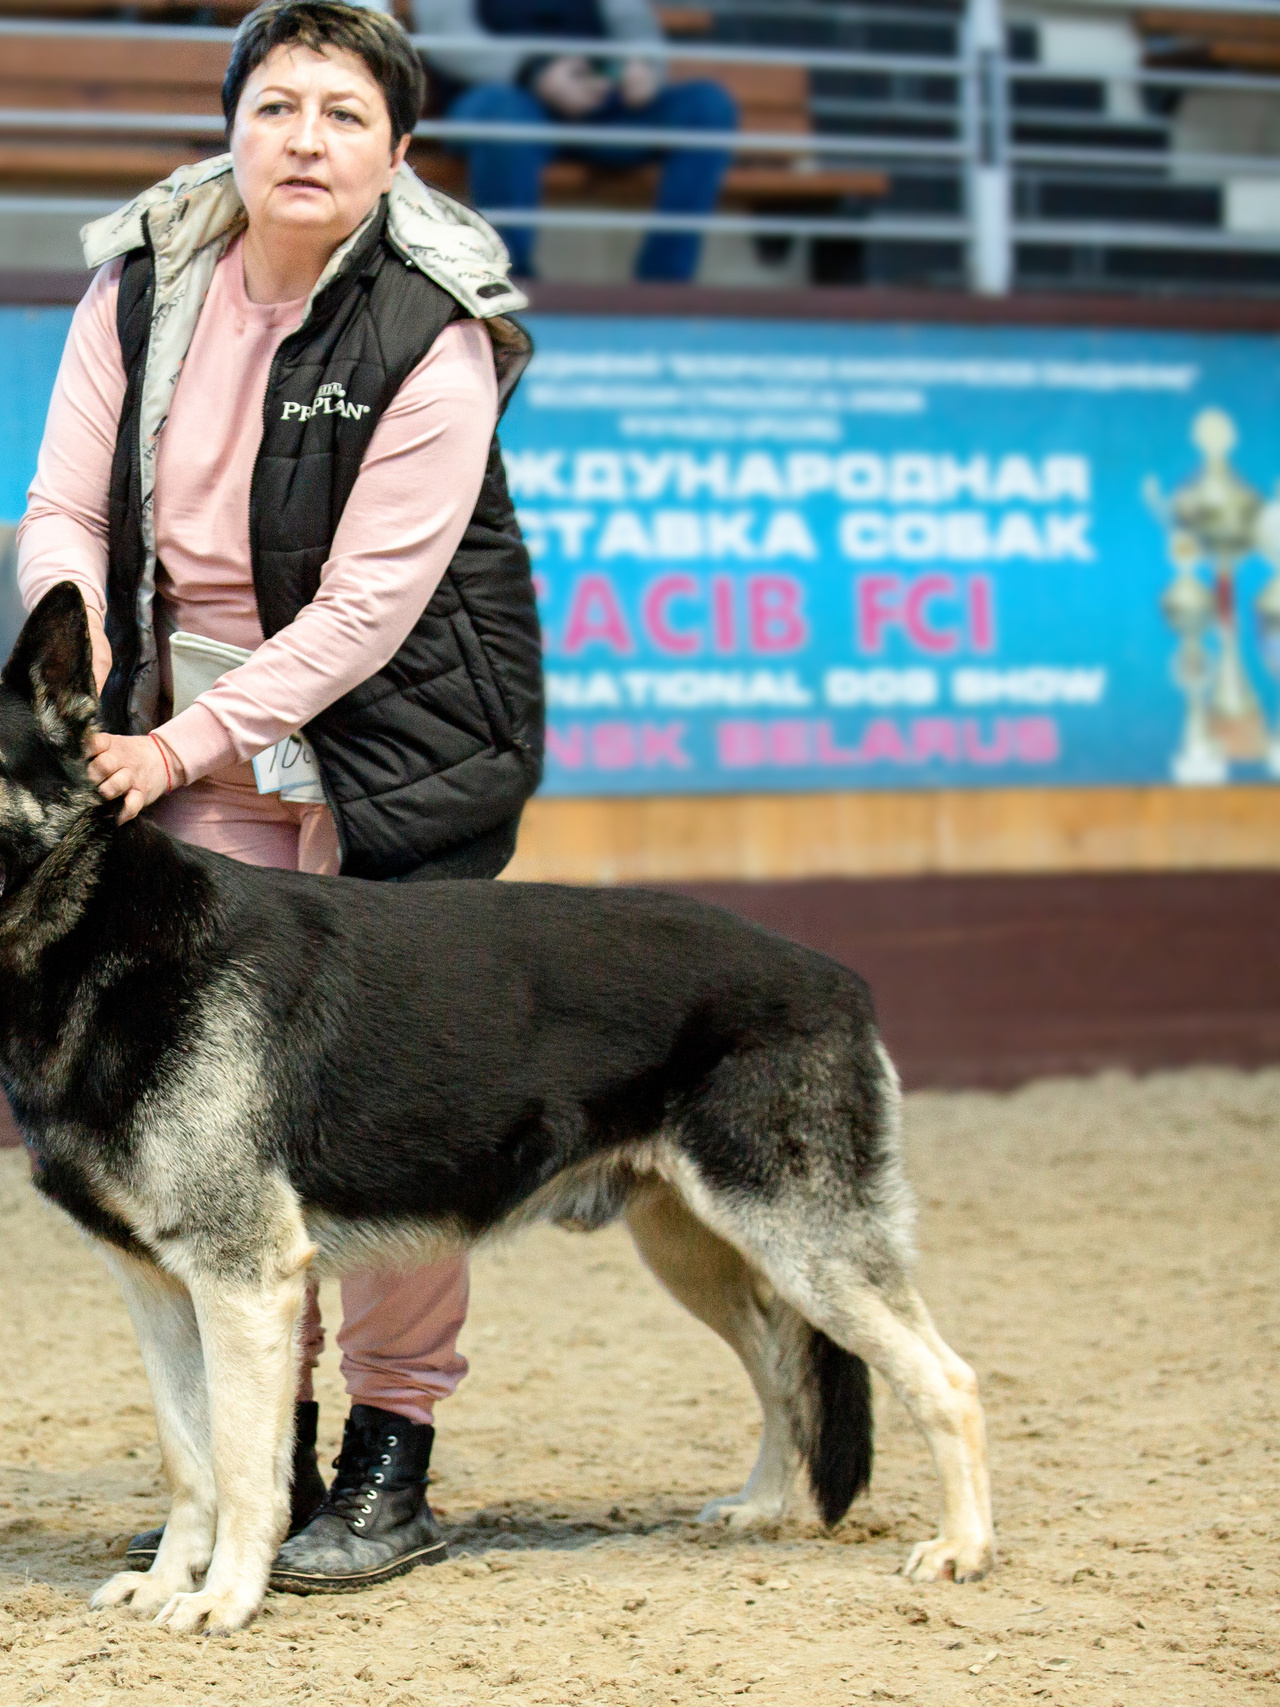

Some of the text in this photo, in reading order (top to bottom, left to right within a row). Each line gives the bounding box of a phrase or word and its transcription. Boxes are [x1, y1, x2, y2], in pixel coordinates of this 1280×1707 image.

[839, 511, 1097, 562] СОБАК
[856, 574, 995, 655] FCI
[825, 669, 941, 705] DOG
[951, 668, 1107, 704] SHOW
[719, 716, 1060, 768] BELARUS
